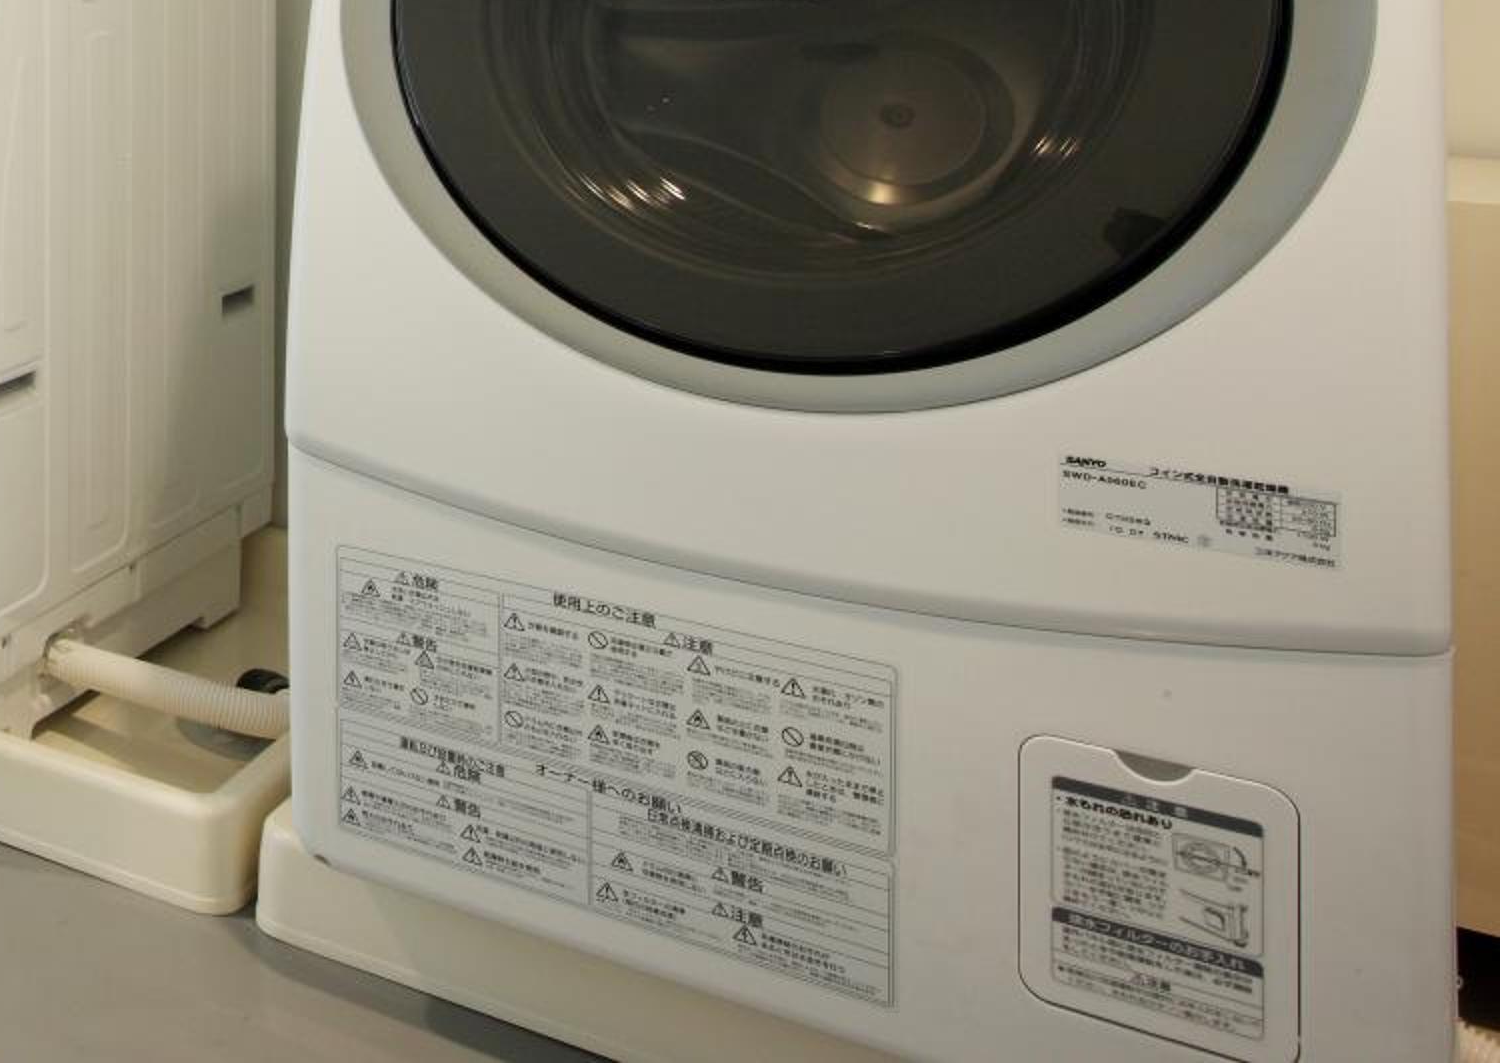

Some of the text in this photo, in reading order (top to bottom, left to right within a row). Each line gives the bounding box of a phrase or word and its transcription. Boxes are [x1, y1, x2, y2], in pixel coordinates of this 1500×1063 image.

[1065, 456, 1107, 467] SANYO
[553, 590, 657, 629] 使用上のご注意
[680, 634, 713, 655] 注意
[535, 764, 682, 813] オーナー様へのお願い
[730, 870, 764, 893] 警告
[730, 905, 763, 928] 注意
